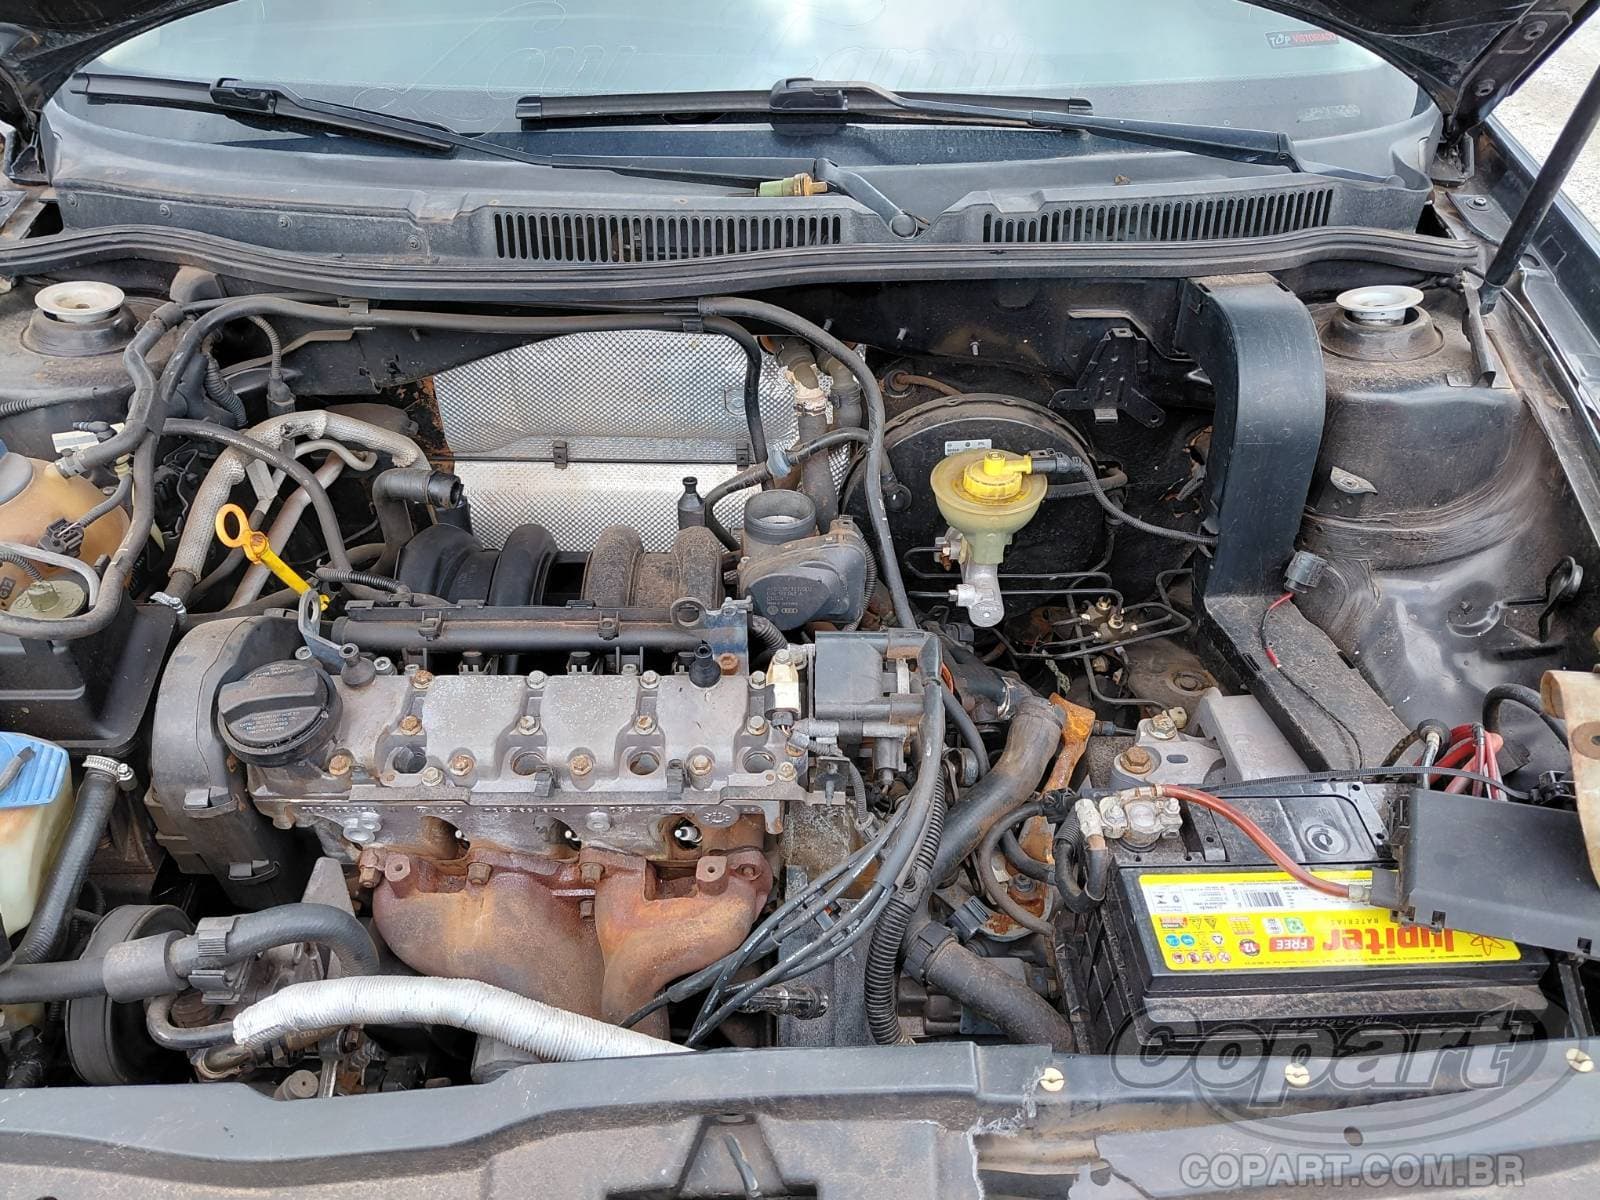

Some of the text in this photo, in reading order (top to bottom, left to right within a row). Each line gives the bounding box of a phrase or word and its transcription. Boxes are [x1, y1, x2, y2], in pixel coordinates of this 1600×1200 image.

[1269, 33, 1291, 47] TOP
[1244, 942, 1257, 953] 12
[1276, 939, 1308, 950] FREE
